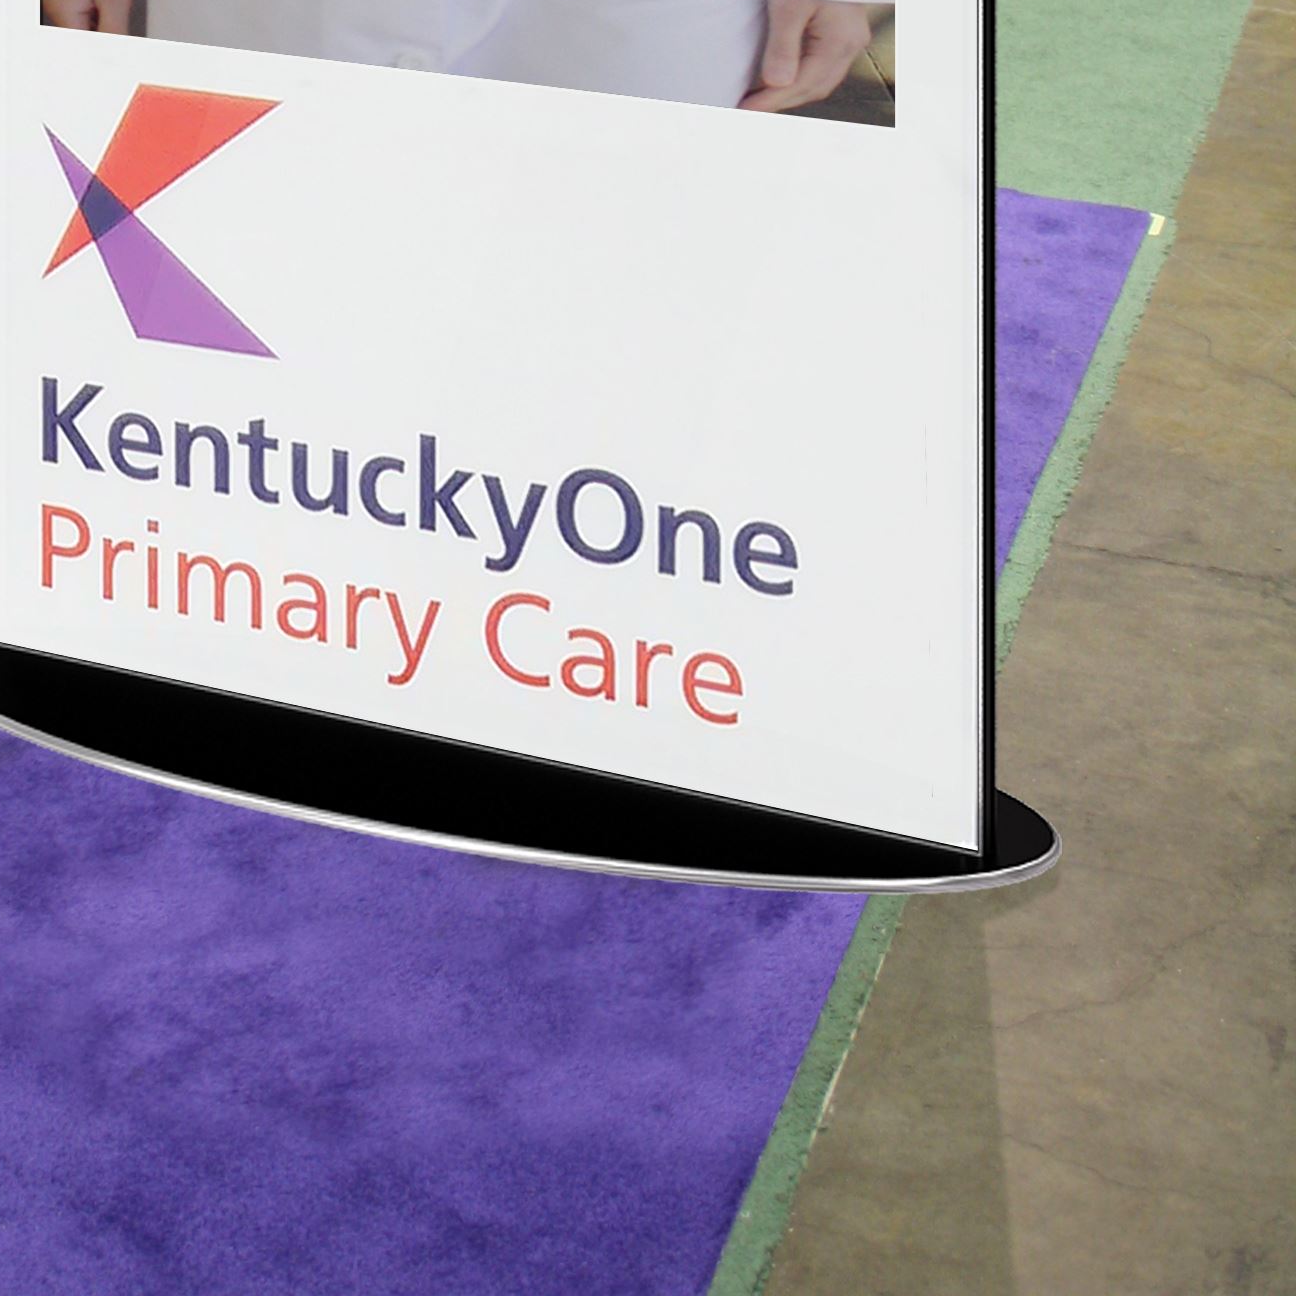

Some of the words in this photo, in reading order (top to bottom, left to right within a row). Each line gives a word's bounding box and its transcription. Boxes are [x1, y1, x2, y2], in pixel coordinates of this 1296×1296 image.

[41, 375, 800, 597] KentuckyOne
[40, 502, 442, 685] Primary
[483, 592, 745, 725] Care
